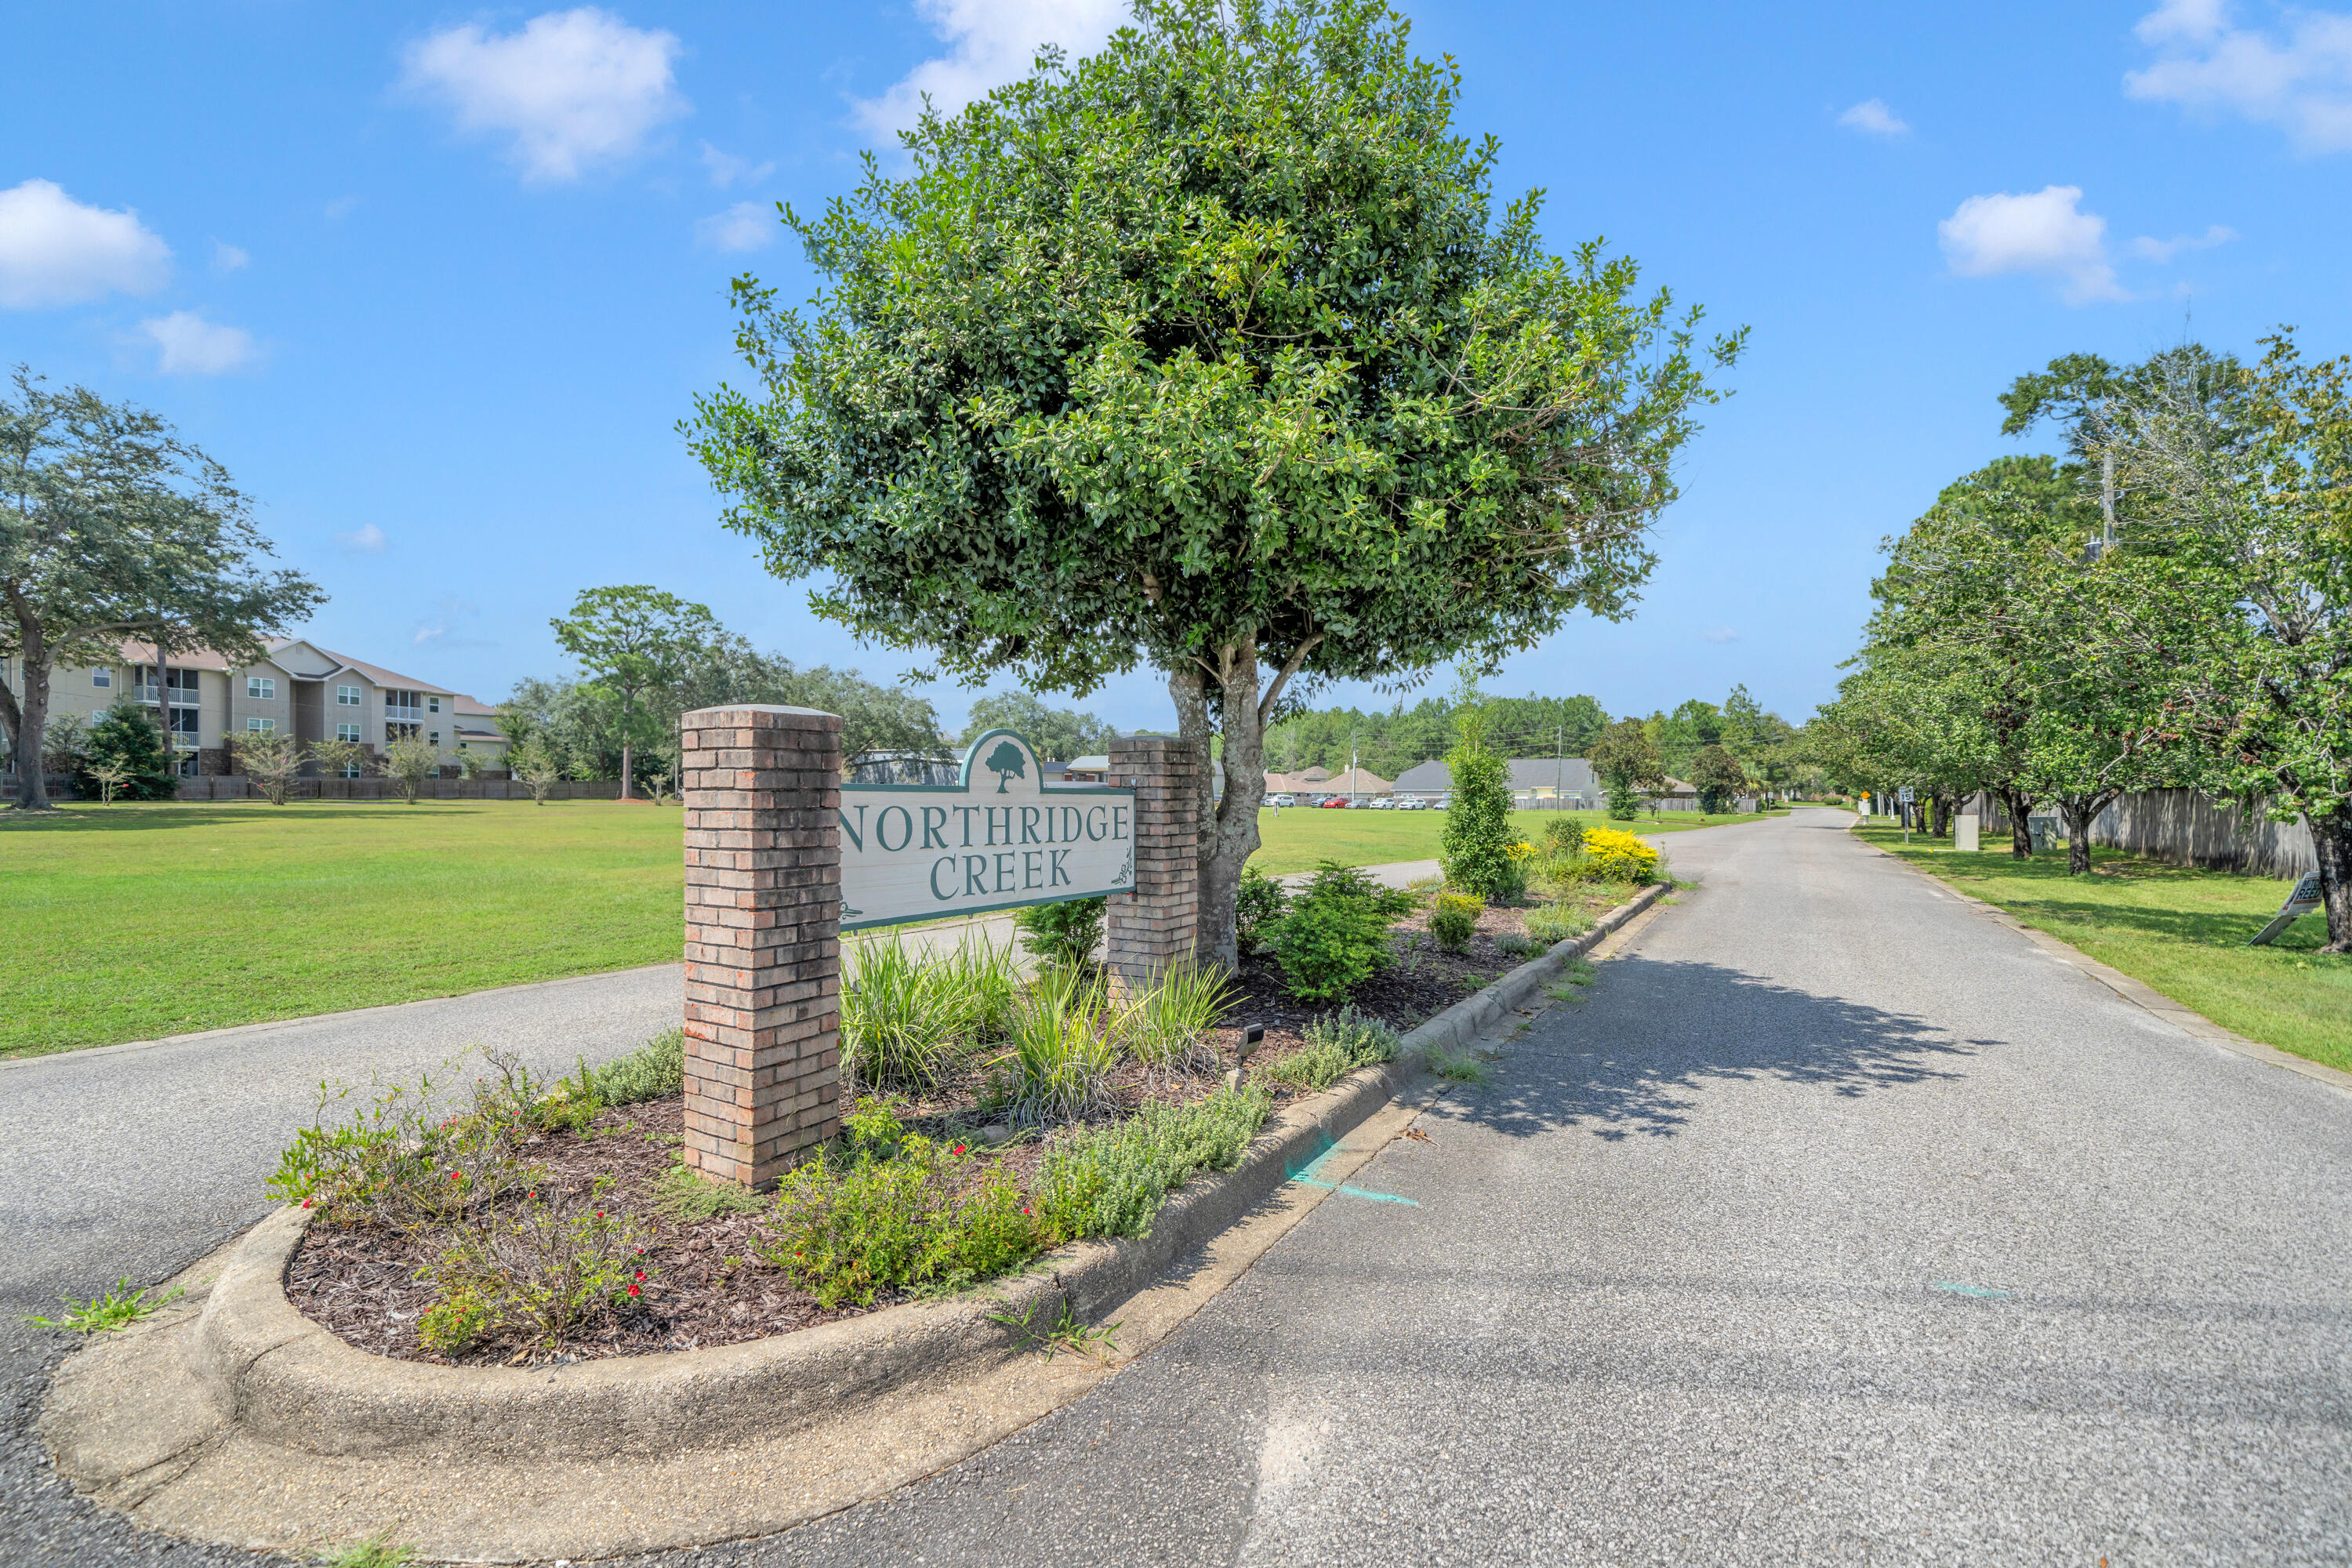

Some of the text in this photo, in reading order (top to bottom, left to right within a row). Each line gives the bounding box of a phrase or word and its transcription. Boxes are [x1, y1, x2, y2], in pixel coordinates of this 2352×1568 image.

[839, 804, 1128, 853] NORTHRIDGE
[930, 849, 1072, 901] CREEK
[2296, 887, 2321, 900] REED
